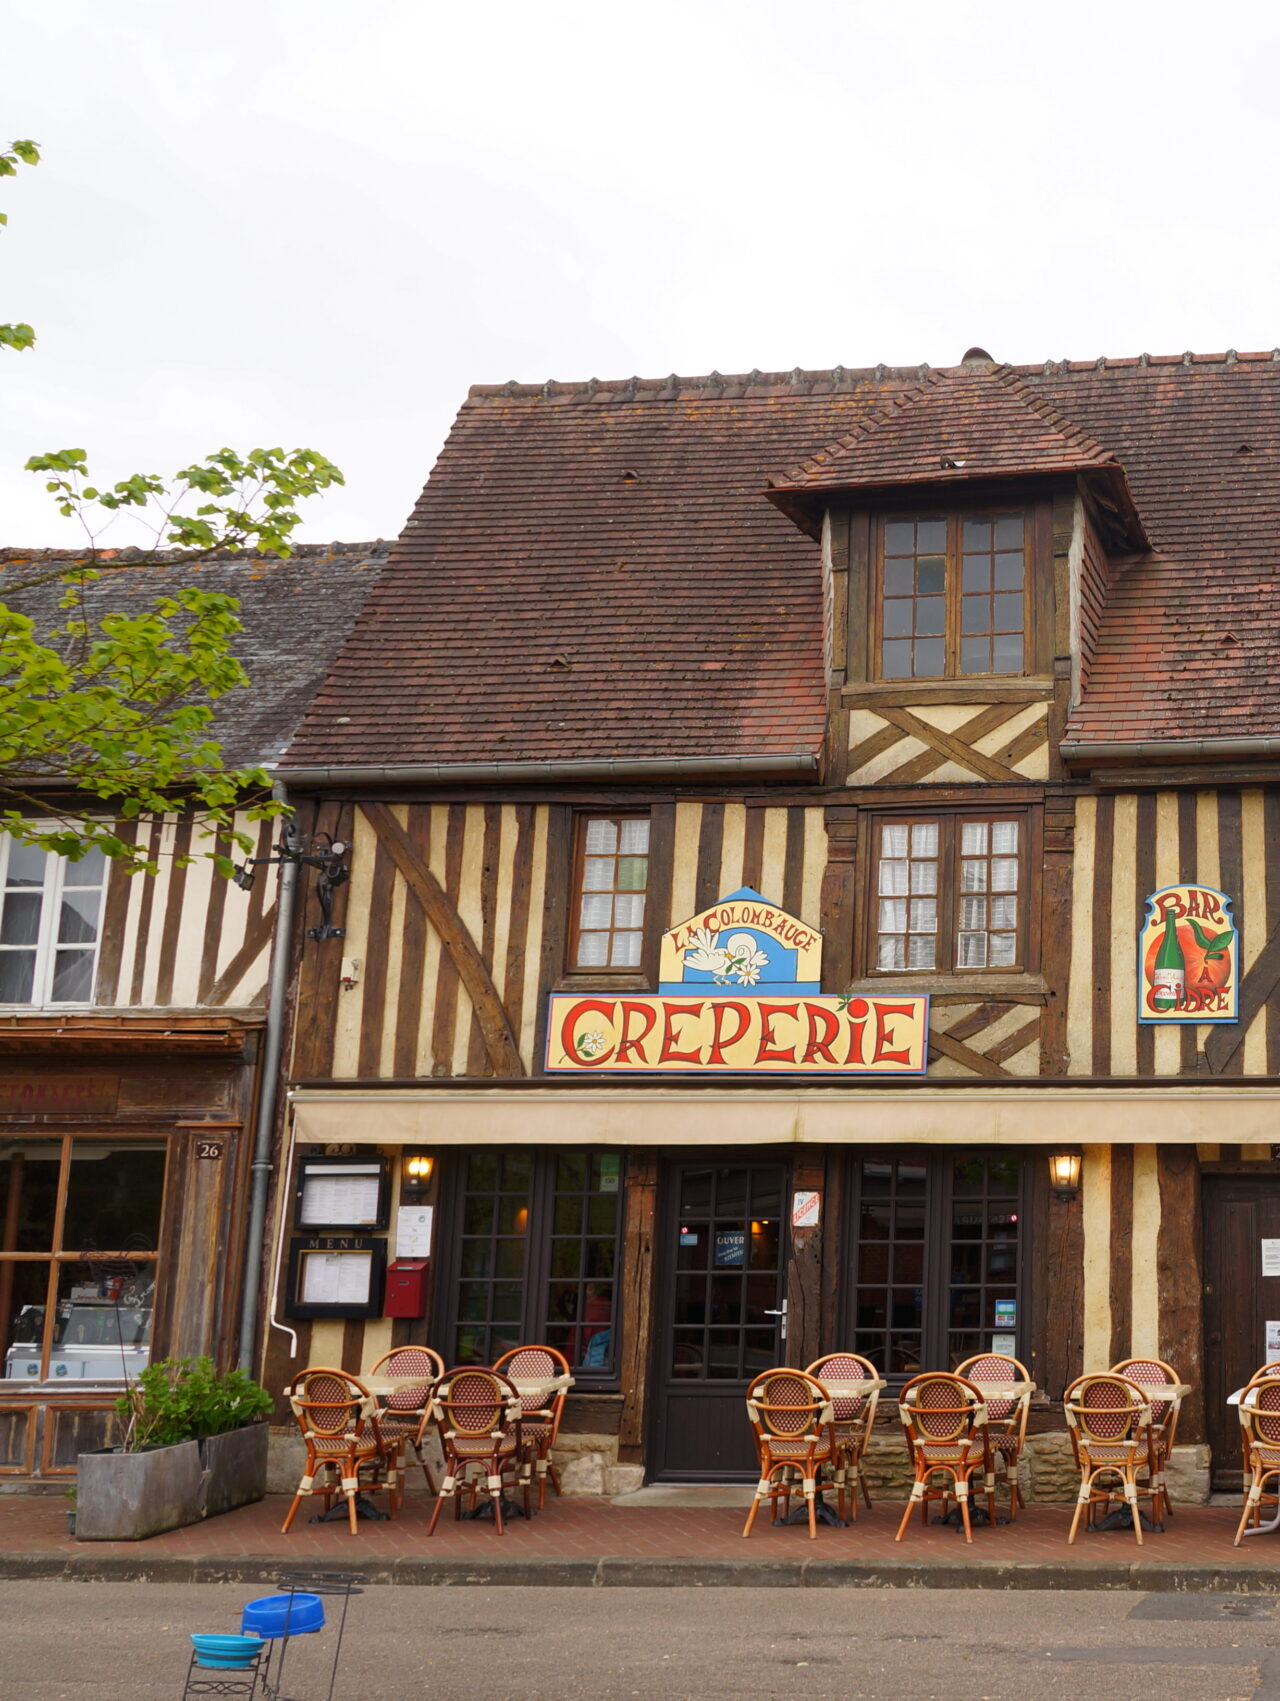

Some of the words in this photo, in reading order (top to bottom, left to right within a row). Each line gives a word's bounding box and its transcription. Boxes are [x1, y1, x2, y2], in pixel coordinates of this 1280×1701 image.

[1151, 889, 1224, 927] BAR
[201, 1144, 218, 1157] 26
[309, 1239, 363, 1249] MENU
